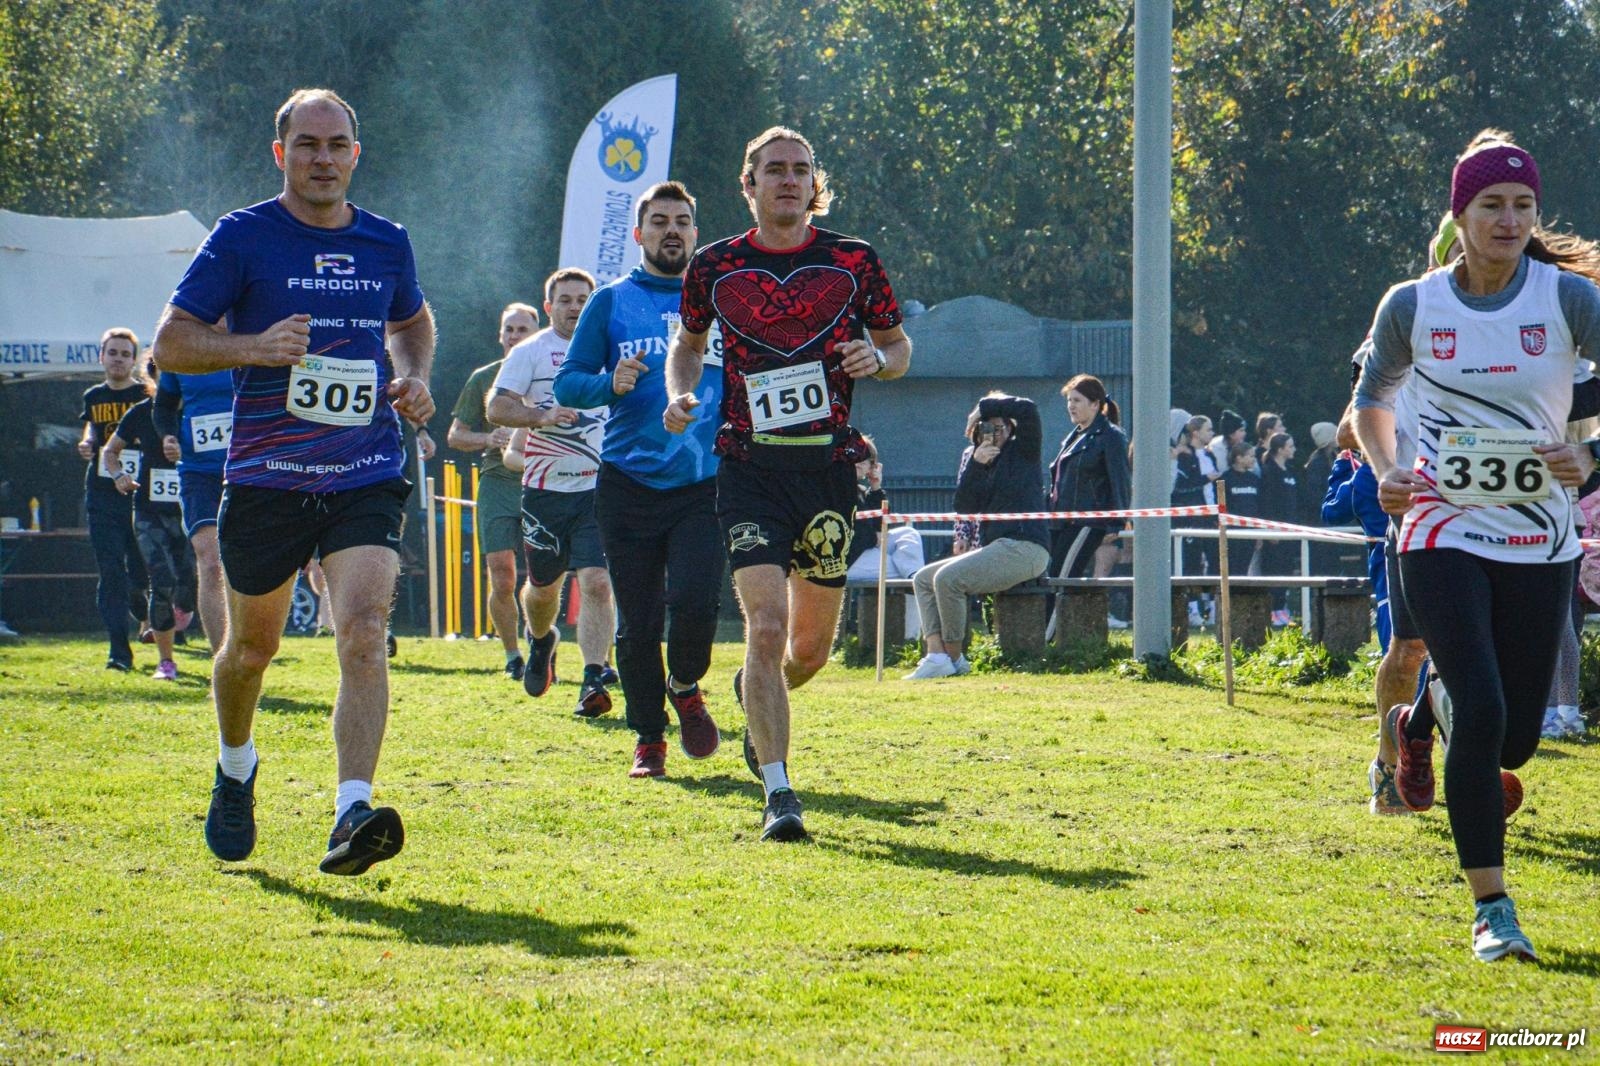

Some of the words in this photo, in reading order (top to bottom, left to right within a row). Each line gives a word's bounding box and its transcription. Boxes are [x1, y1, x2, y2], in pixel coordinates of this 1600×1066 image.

[287, 277, 382, 292] FEROCITY
[350, 318, 382, 328] TEAM
[293, 378, 373, 415] 305
[755, 384, 824, 420] 150
[1443, 455, 1544, 494] 336
